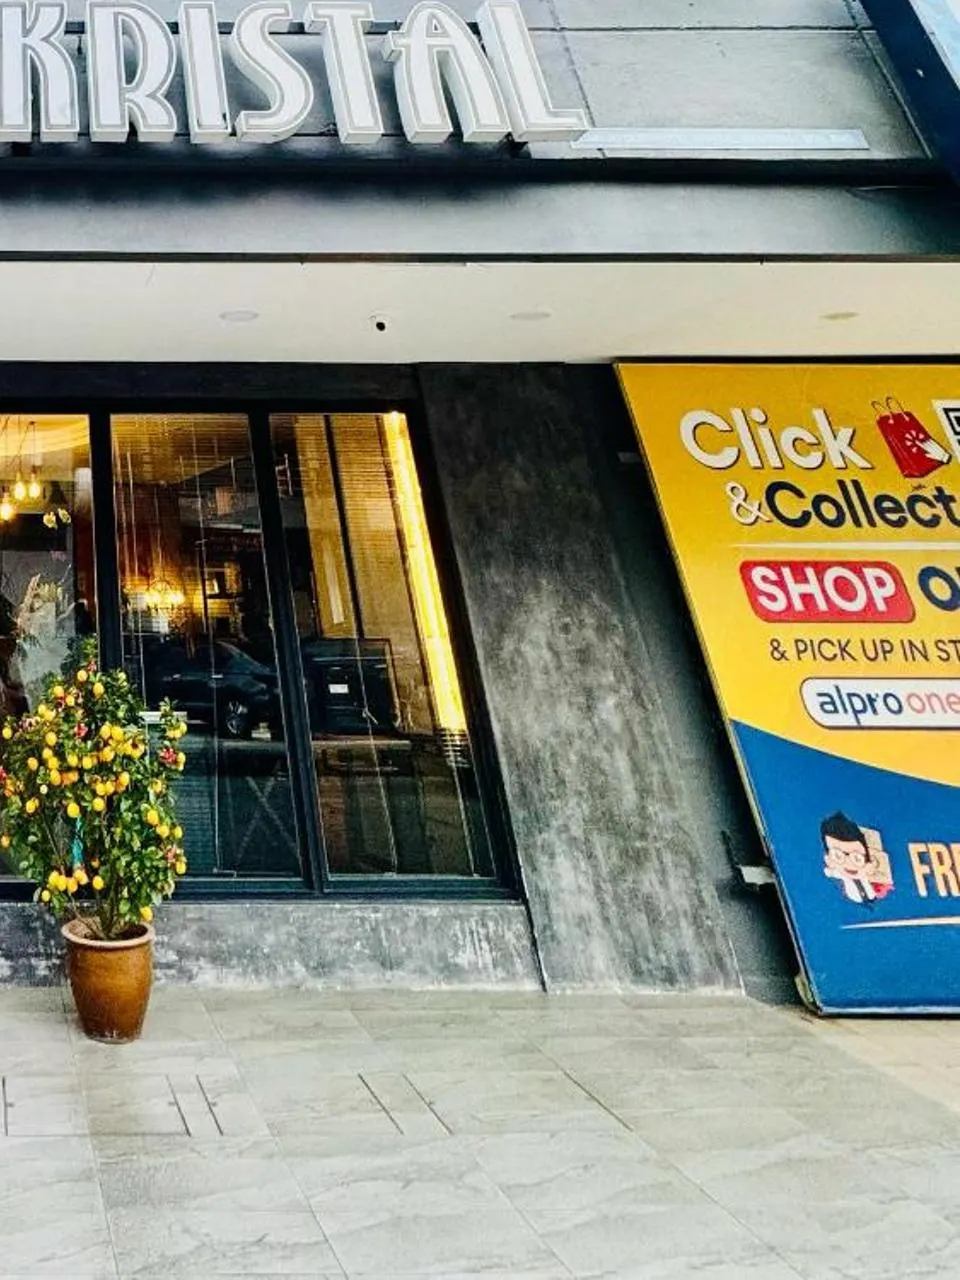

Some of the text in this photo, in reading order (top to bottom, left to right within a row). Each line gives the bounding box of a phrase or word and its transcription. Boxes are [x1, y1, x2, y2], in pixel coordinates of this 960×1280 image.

[681, 407, 875, 470] Click
[751, 566, 897, 613] SHOP
[770, 638, 789, 662] &
[794, 638, 857, 662] PICK
[860, 639, 895, 662] UP
[902, 639, 930, 662] IN
